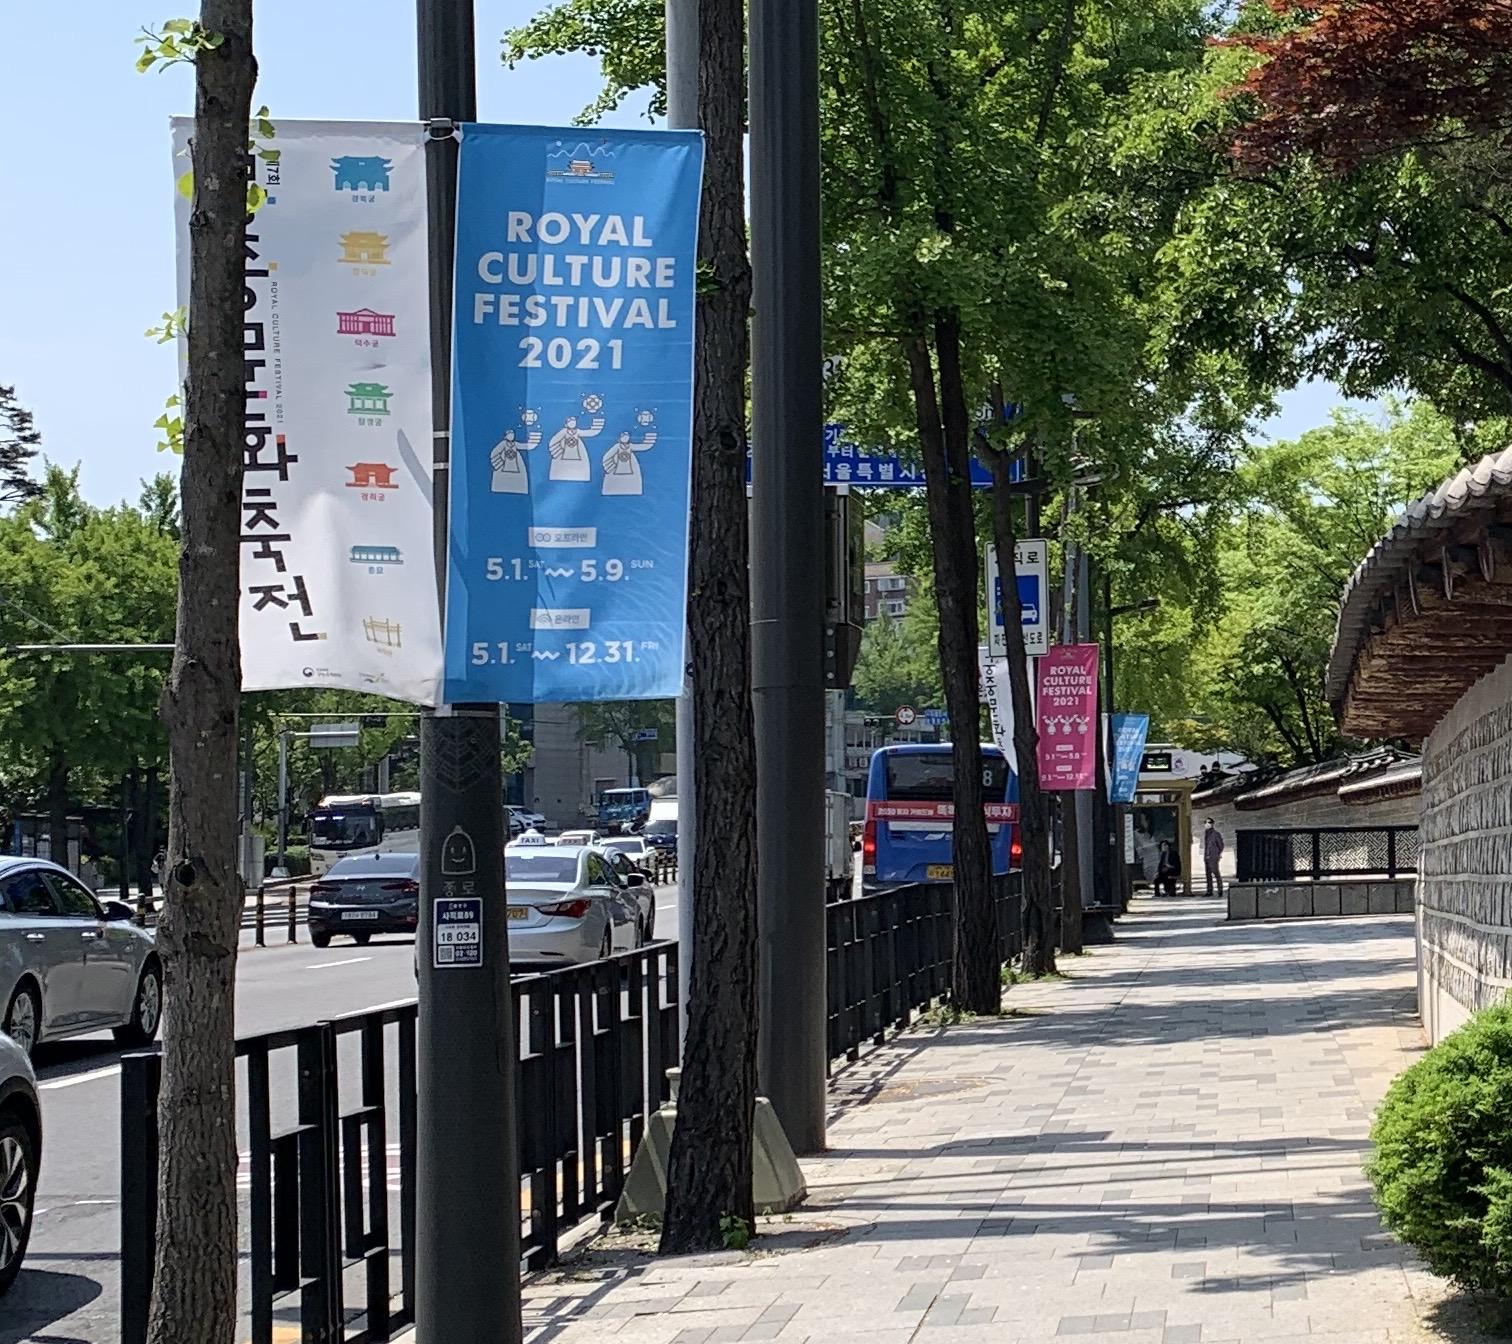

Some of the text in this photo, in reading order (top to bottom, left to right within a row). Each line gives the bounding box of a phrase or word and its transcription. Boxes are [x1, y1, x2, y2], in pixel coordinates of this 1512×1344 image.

[507, 211, 653, 247] ROYAL
[478, 251, 676, 288] CULTURE
[473, 293, 677, 328] FESTIVAL
[518, 336, 623, 369] 2021
[486, 558, 529, 581] 5.1.
[580, 558, 630, 582] 5.9.
[631, 559, 654, 569] SUN
[471, 642, 516, 665] 5.1.
[565, 640, 641, 665] 12.31.
[1050, 665, 1087, 675] ROYAL
[1043, 676, 1092, 685] CULTURE
[1042, 686, 1092, 696] FESTIVAL
[1053, 696, 1079, 706] 2021
[443, 881, 475, 897] 종로
[456, 931, 477, 942] 034
